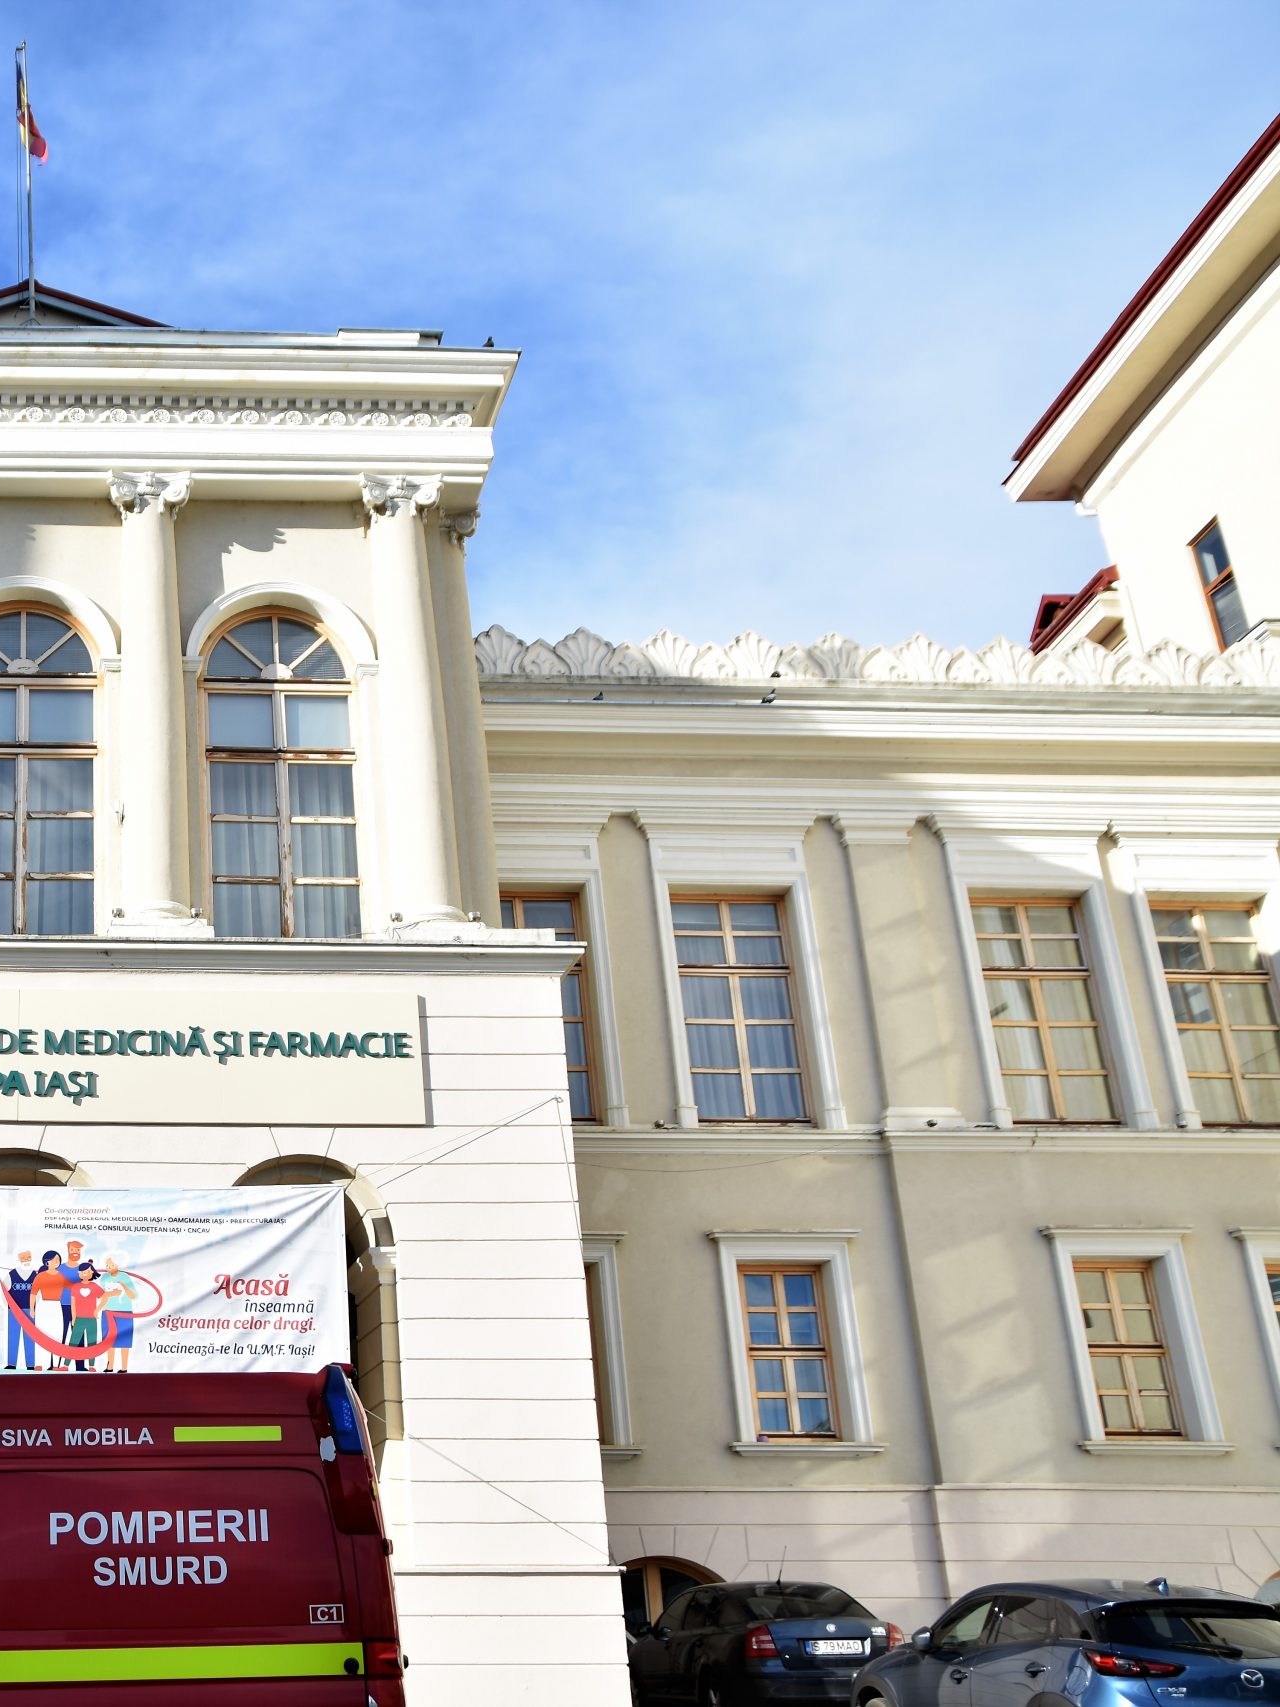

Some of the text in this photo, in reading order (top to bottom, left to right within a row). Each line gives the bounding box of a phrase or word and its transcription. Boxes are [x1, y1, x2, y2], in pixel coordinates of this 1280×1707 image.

[44, 1026, 209, 1056] MEDICINĂ
[249, 1031, 412, 1058] FARMACIE
[44, 1206, 111, 1215] Co-organizatori:
[97, 1224, 133, 1232] CONSILIUL
[213, 1273, 290, 1300] Acasă
[244, 1299, 314, 1314] înseamnă
[233, 1316, 271, 1330] celor
[273, 1316, 316, 1334] dragi.
[148, 1342, 231, 1357] Vaccinează-te
[233, 1342, 245, 1355] la
[246, 1344, 285, 1357] U.M.F.
[64, 1427, 154, 1446] MOBILA
[48, 1508, 270, 1546] POMPIERII
[92, 1555, 228, 1587] SMURD
[316, 1606, 338, 1622] C1
